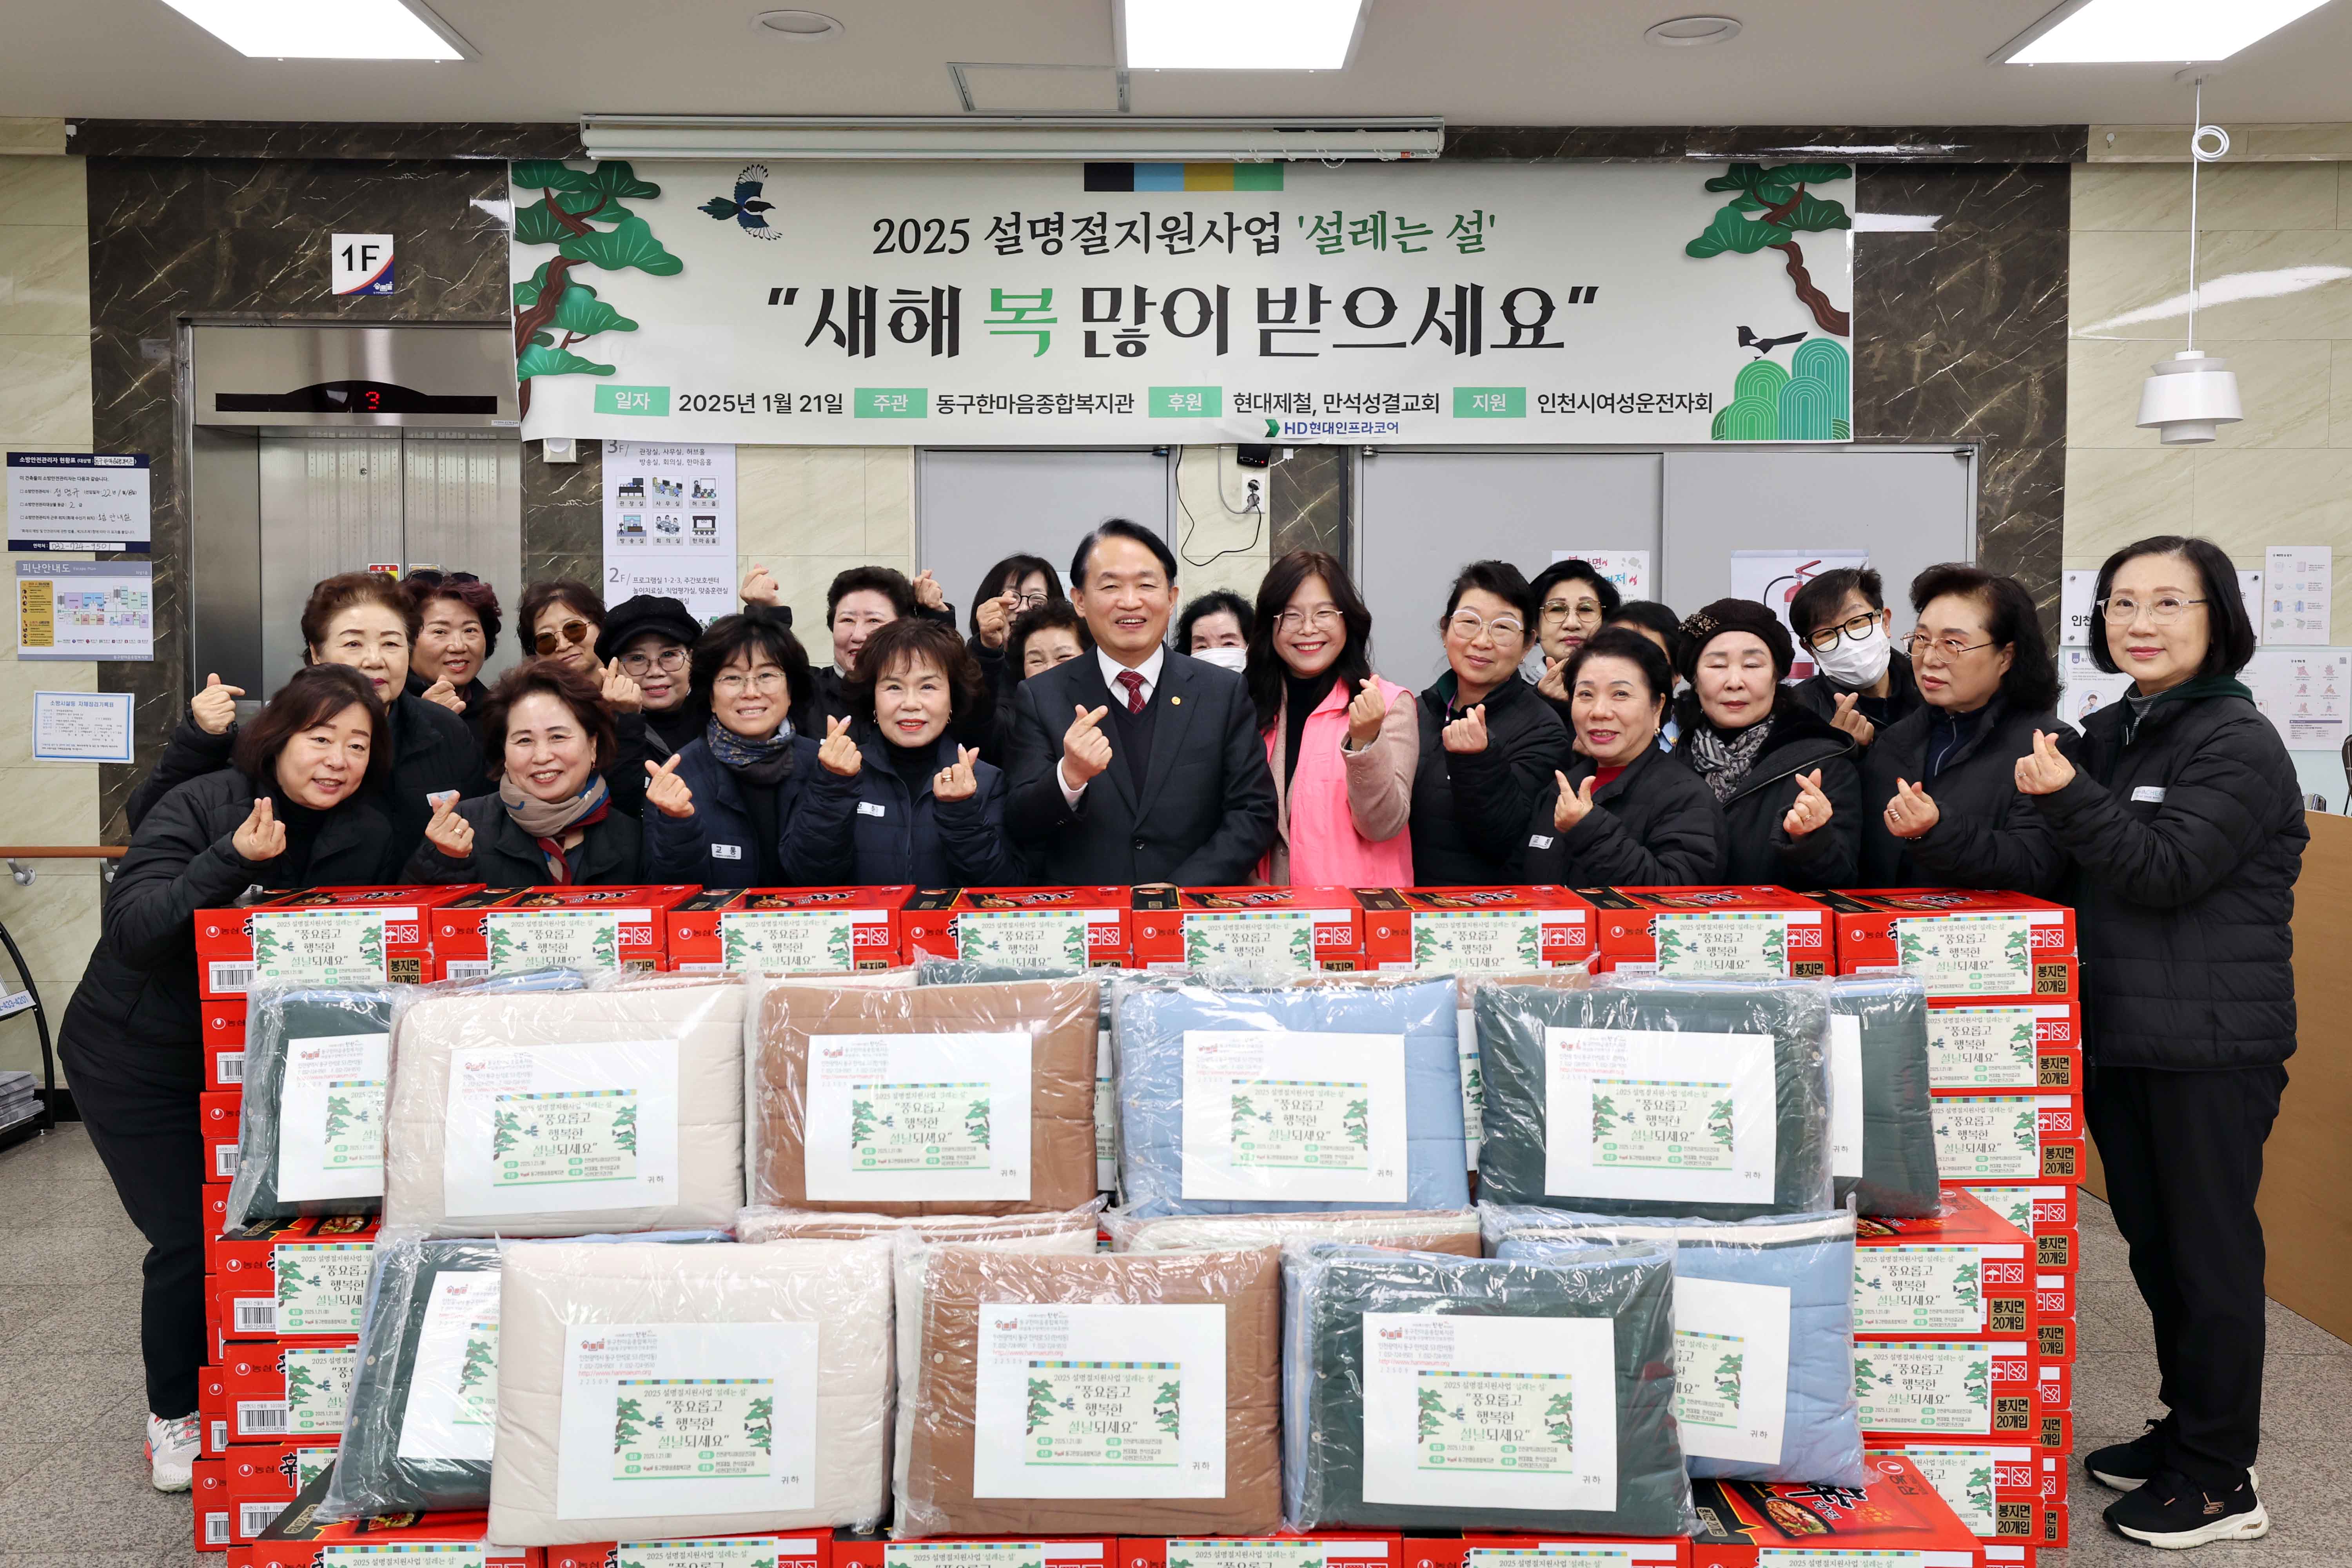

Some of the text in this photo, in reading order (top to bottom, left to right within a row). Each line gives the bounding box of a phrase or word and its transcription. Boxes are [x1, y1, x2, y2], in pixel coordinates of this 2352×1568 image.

[873, 210, 1495, 256] 2025 설명절지원사업 '설레는 설'
[342, 244, 381, 272] 1F
[768, 283, 1599, 358] "새해 복 많이 받으세요"
[614, 391, 1712, 416] 일자 2025년 1월 21일 주관 동구한마음종합복지관 후원 현대제철, 만석성결교회 지원 인천시여성운전자회
[1285, 422, 1398, 434] HD현대인프라코어
[687, 448, 704, 457] 허브홀
[23, 564, 71, 573] 피난안내도
[2072, 615, 2092, 626] 인천
[295, 929, 340, 940] "풍요롭고
[764, 929, 808, 940] "풍요롭고
[1698, 933, 1742, 943] "풍요롭고
[1940, 934, 1985, 944] "풍요롭고
[304, 943, 334, 953] 행복한
[773, 943, 802, 953] 행복한
[1707, 947, 1736, 956] 행복한
[1950, 947, 1979, 958] 행복한
[292, 956, 347, 966] 설날되세요"
[391, 959, 419, 971] 봉지면
[760, 956, 815, 966] 설날되세요"
[1694, 960, 1749, 969] 설날되세요"
[1937, 961, 1993, 971] 설날되세요"
[2038, 965, 2067, 977] 봉지면
[2038, 981, 2067, 993] 20개입
[2040, 1057, 2069, 1069] 봉지면
[2040, 1072, 2069, 1085] 20개입
[2045, 1147, 2074, 1160] 봉지면
[2045, 1161, 2074, 1174] 20개입
[2038, 1237, 2067, 1250] 봉지면
[2038, 1252, 2067, 1264] 20개입
[1883, 1266, 1932, 1276] "풍요롭고
[331, 1280, 363, 1291] 행복한
[1893, 1280, 1925, 1291] 행복한
[1878, 1295, 1940, 1305] 설날되세요"
[1993, 1301, 2024, 1314] 봉지면
[1993, 1318, 2024, 1330] 20개입
[644, 1388, 712, 1397] 2025 설명절지원사업
[1466, 1394, 1521, 1406] "풍요롭고
[1997, 1399, 2028, 1412] 봉지면
[666, 1401, 722, 1413] "풍요롭고
[676, 1417, 713, 1430] 행복한
[1477, 1411, 1513, 1424] 행복한
[1997, 1416, 2028, 1428] 20개입
[659, 1435, 729, 1448] 설날되세요"
[1461, 1429, 1529, 1442] 설날되세요"
[1999, 1505, 2030, 1518] 봉지면
[1998, 1521, 2030, 1534] 20개입
[372, 1558, 421, 1567] 설명절지원사업
